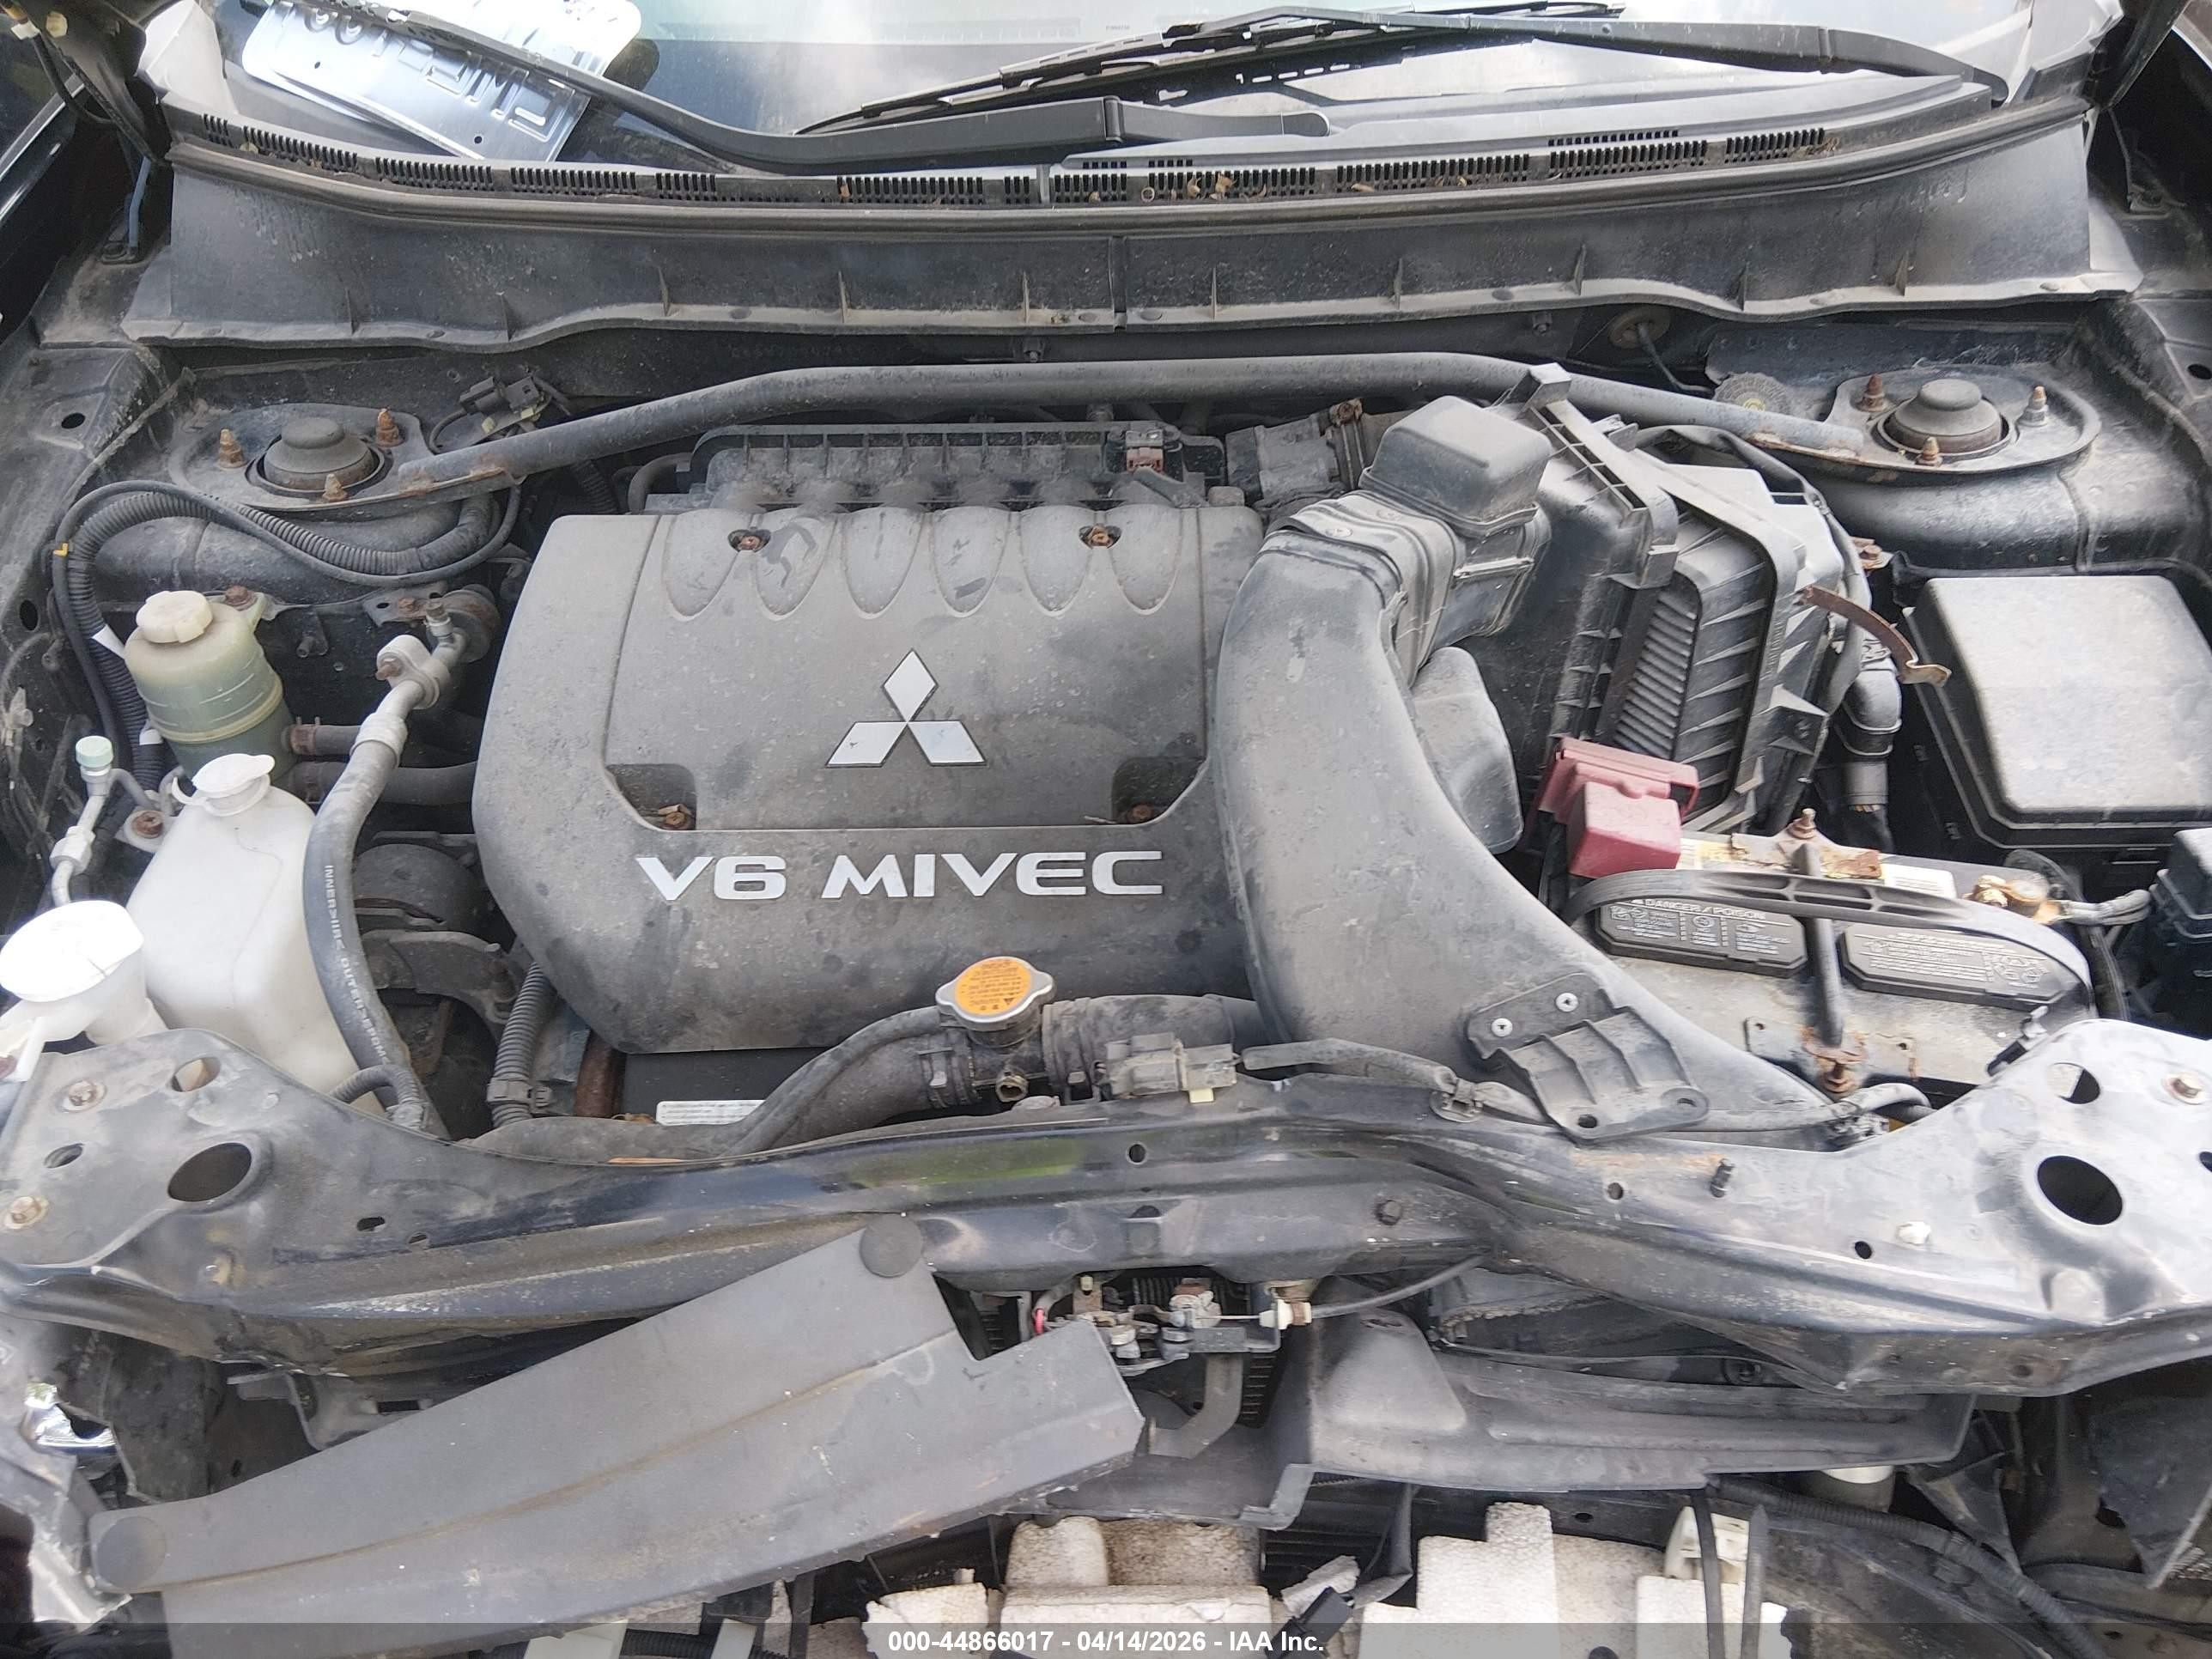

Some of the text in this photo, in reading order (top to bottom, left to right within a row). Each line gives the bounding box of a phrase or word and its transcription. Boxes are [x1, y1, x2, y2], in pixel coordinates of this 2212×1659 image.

[635, 850, 1163, 901] V6 MIVEC
[1644, 898, 1702, 913] DANGER
[1713, 907, 1766, 921] POISON
